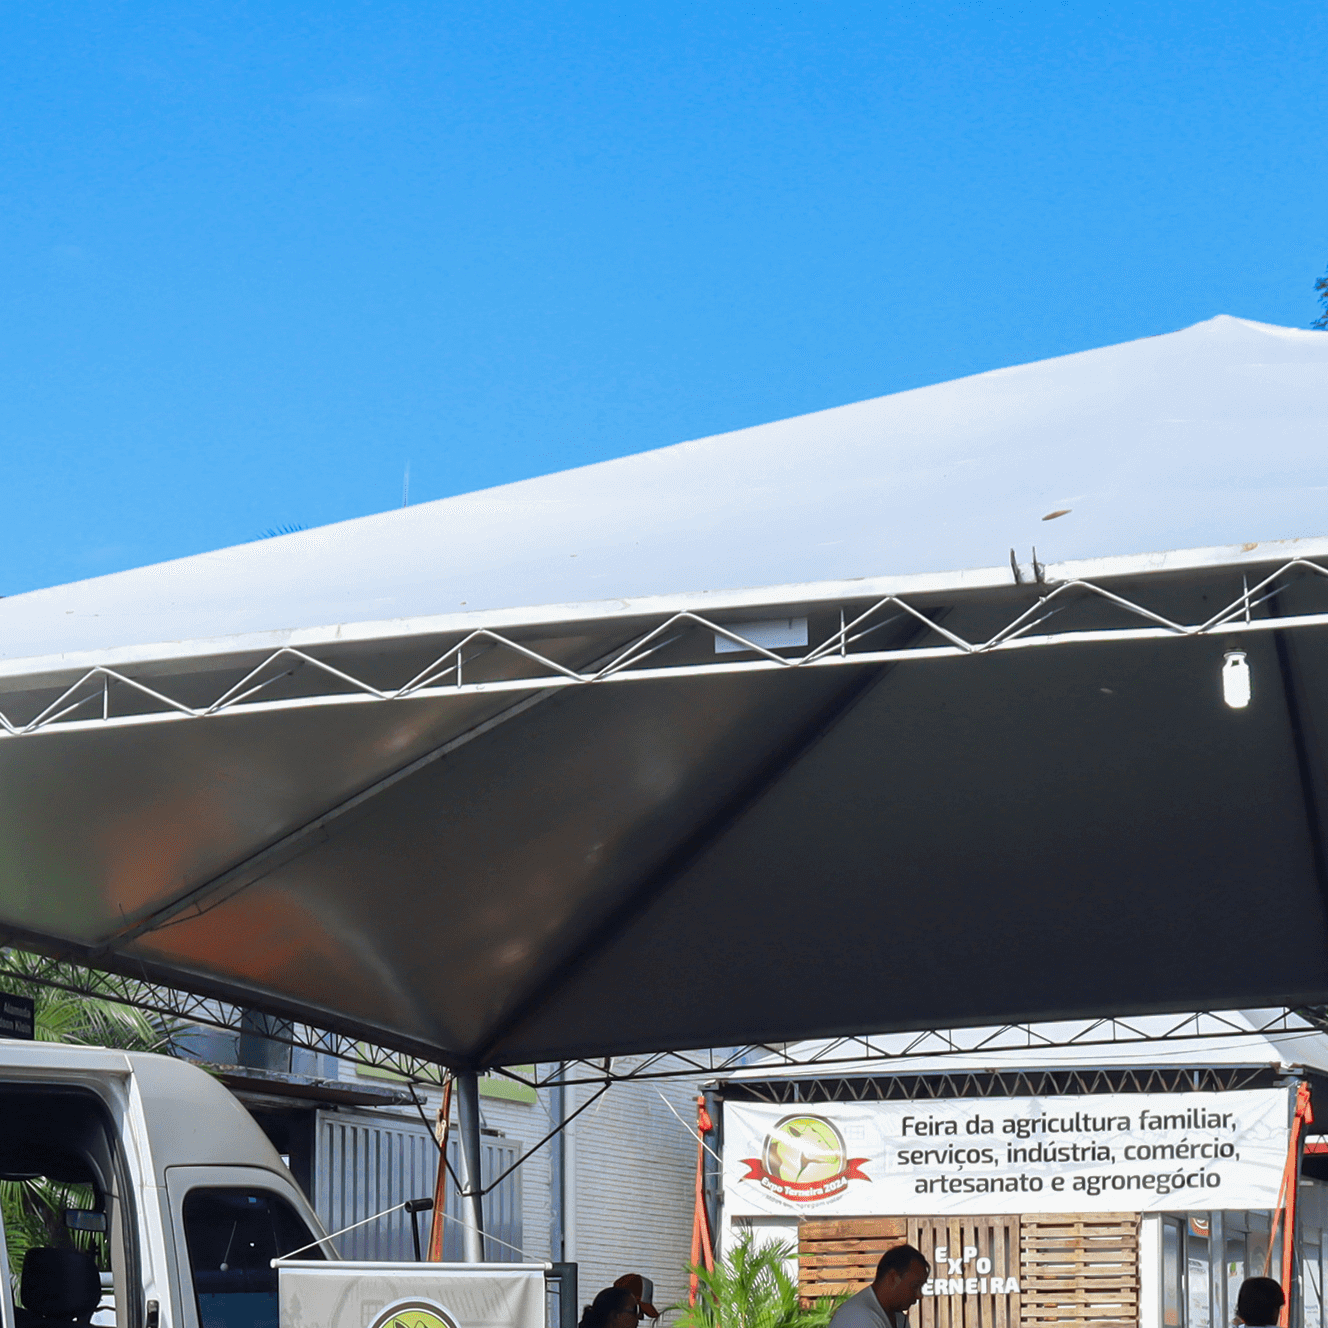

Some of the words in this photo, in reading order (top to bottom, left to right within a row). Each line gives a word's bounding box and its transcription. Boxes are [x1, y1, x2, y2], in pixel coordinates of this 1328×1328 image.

[901, 1114, 958, 1137] Feira
[965, 1114, 994, 1135] da
[1002, 1111, 1131, 1139] agricultura
[1138, 1108, 1237, 1132] familiar,
[897, 1143, 1000, 1171] serviços,
[1006, 1141, 1116, 1165] indústria,
[1123, 1137, 1241, 1161] comércio,
[761, 1177, 783, 1193] Expo
[784, 1185, 823, 1196] Terneira
[914, 1172, 1044, 1194] artesanato
[1050, 1175, 1065, 1191] e
[1072, 1167, 1221, 1196] agronegócio
[921, 1277, 1020, 1296] ERNEIRA
